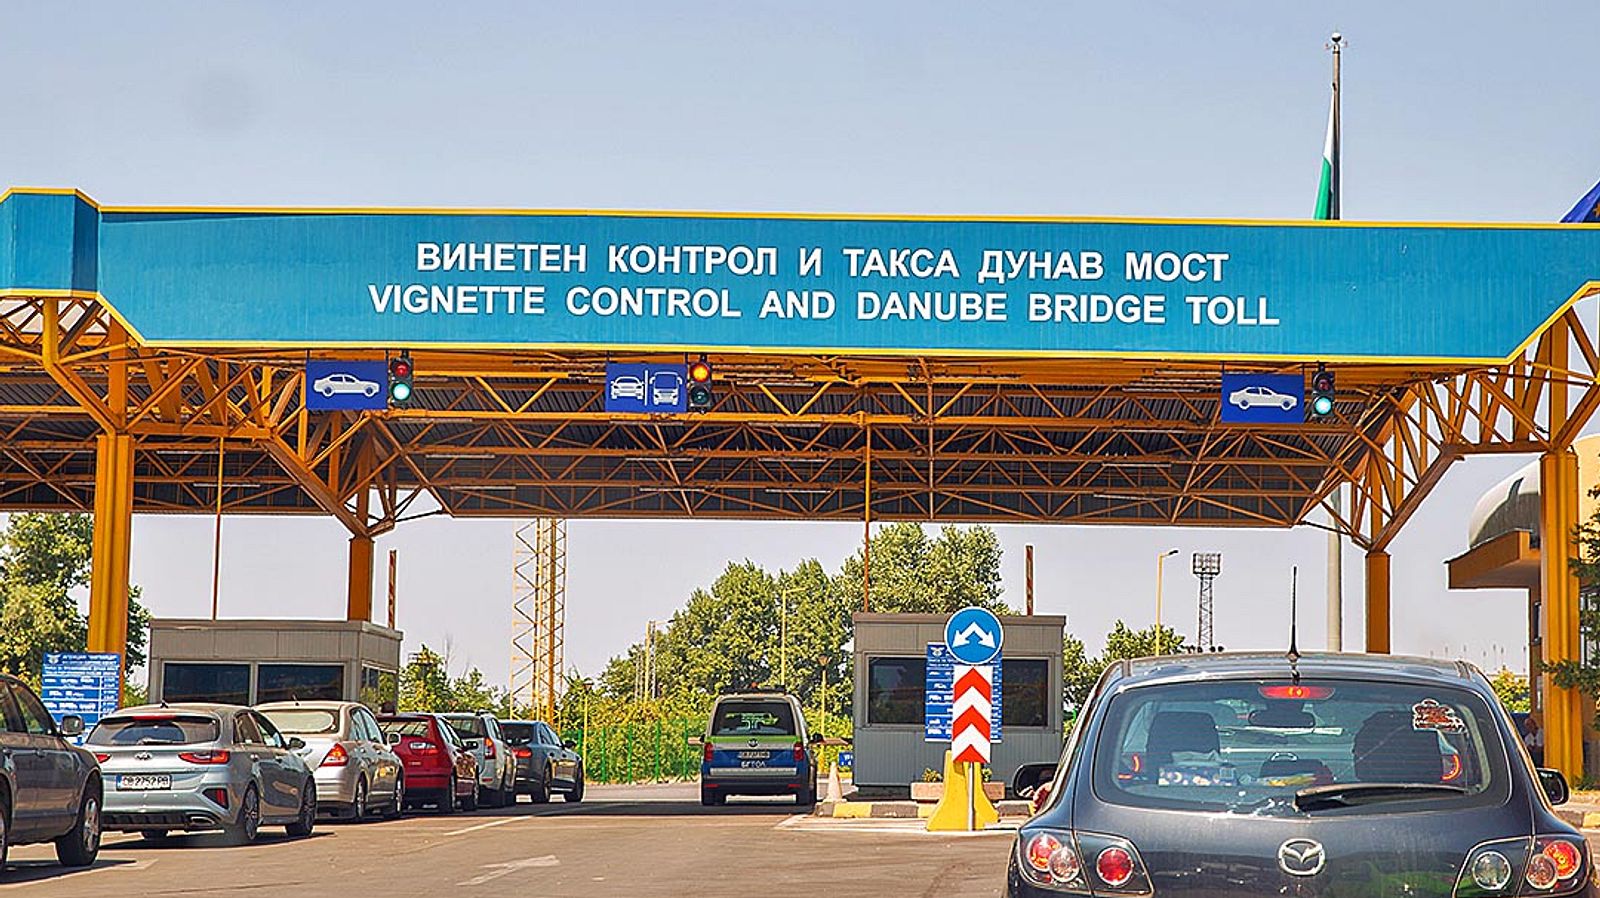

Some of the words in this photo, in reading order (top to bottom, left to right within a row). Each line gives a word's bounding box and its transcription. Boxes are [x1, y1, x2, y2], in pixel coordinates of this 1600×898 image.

[417, 243, 587, 273] ВИНЕТЕН
[608, 245, 777, 276] КОНТРОЛ
[799, 247, 822, 276] И
[842, 248, 960, 279] ТАКСА
[977, 250, 1104, 284] ДУНАВ
[1125, 252, 1229, 282] МОСТ
[368, 284, 546, 315] VIGNETTE
[566, 286, 741, 318] CONTROL
[759, 290, 836, 320] AND
[857, 291, 1008, 322] DANUBE
[1029, 293, 1166, 325] BRIDGE
[1185, 296, 1280, 326] TOLL
